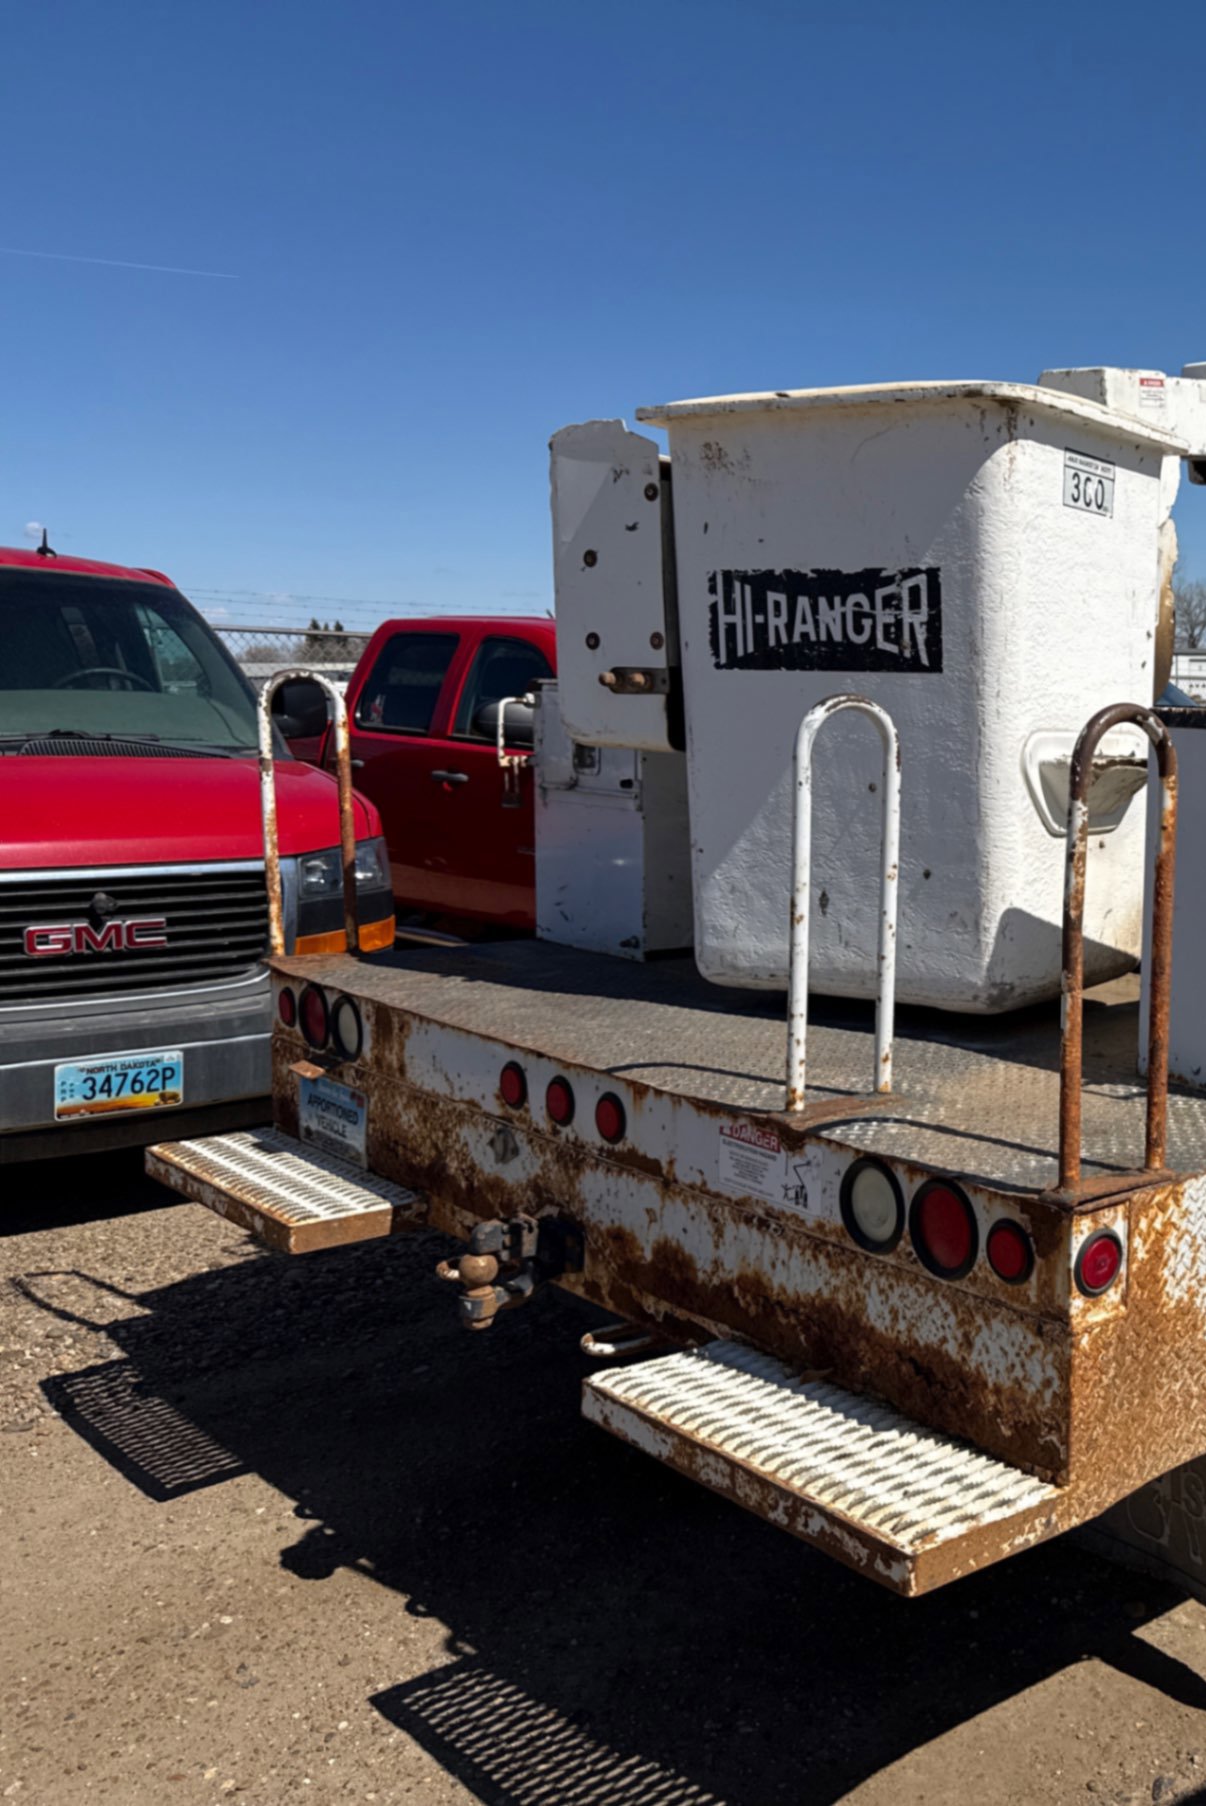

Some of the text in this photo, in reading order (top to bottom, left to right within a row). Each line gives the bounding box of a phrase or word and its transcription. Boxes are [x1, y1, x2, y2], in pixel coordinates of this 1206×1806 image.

[716, 571, 930, 667] HI-RANGER
[25, 918, 167, 957] GMC
[82, 1066, 176, 1101] 34762P
[86, 1060, 157, 1075] NORTH DAKOTA
[732, 1125, 778, 1151] DANGER
